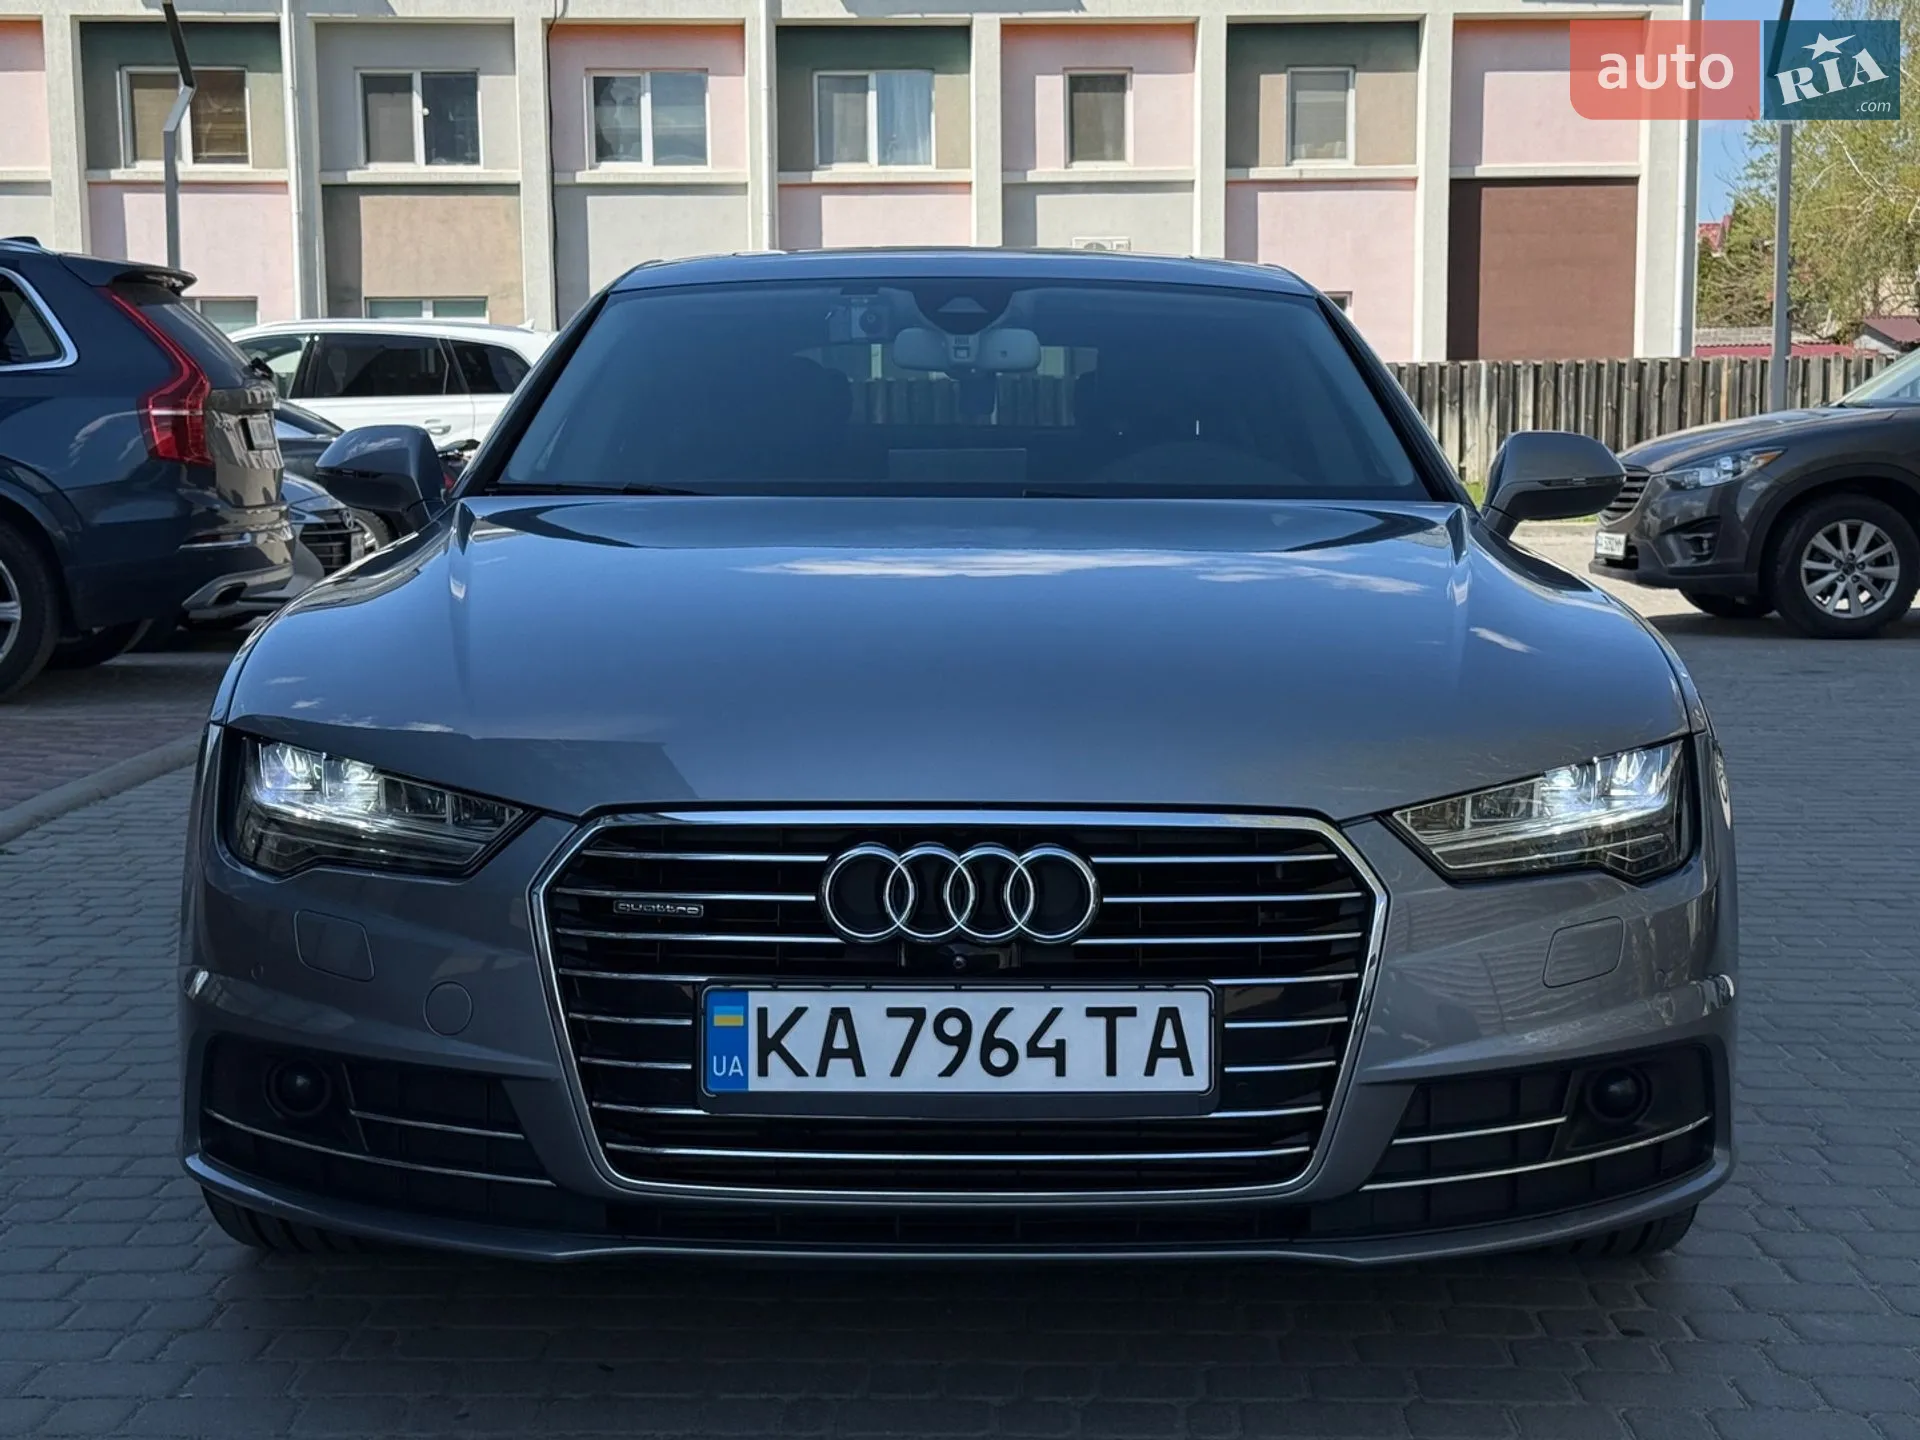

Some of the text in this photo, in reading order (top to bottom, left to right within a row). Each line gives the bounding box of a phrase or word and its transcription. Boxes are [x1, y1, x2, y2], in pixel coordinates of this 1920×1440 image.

[618, 902, 699, 914] quattro
[757, 1007, 1195, 1077] KA 7964 TA
[712, 1055, 744, 1077] UA
